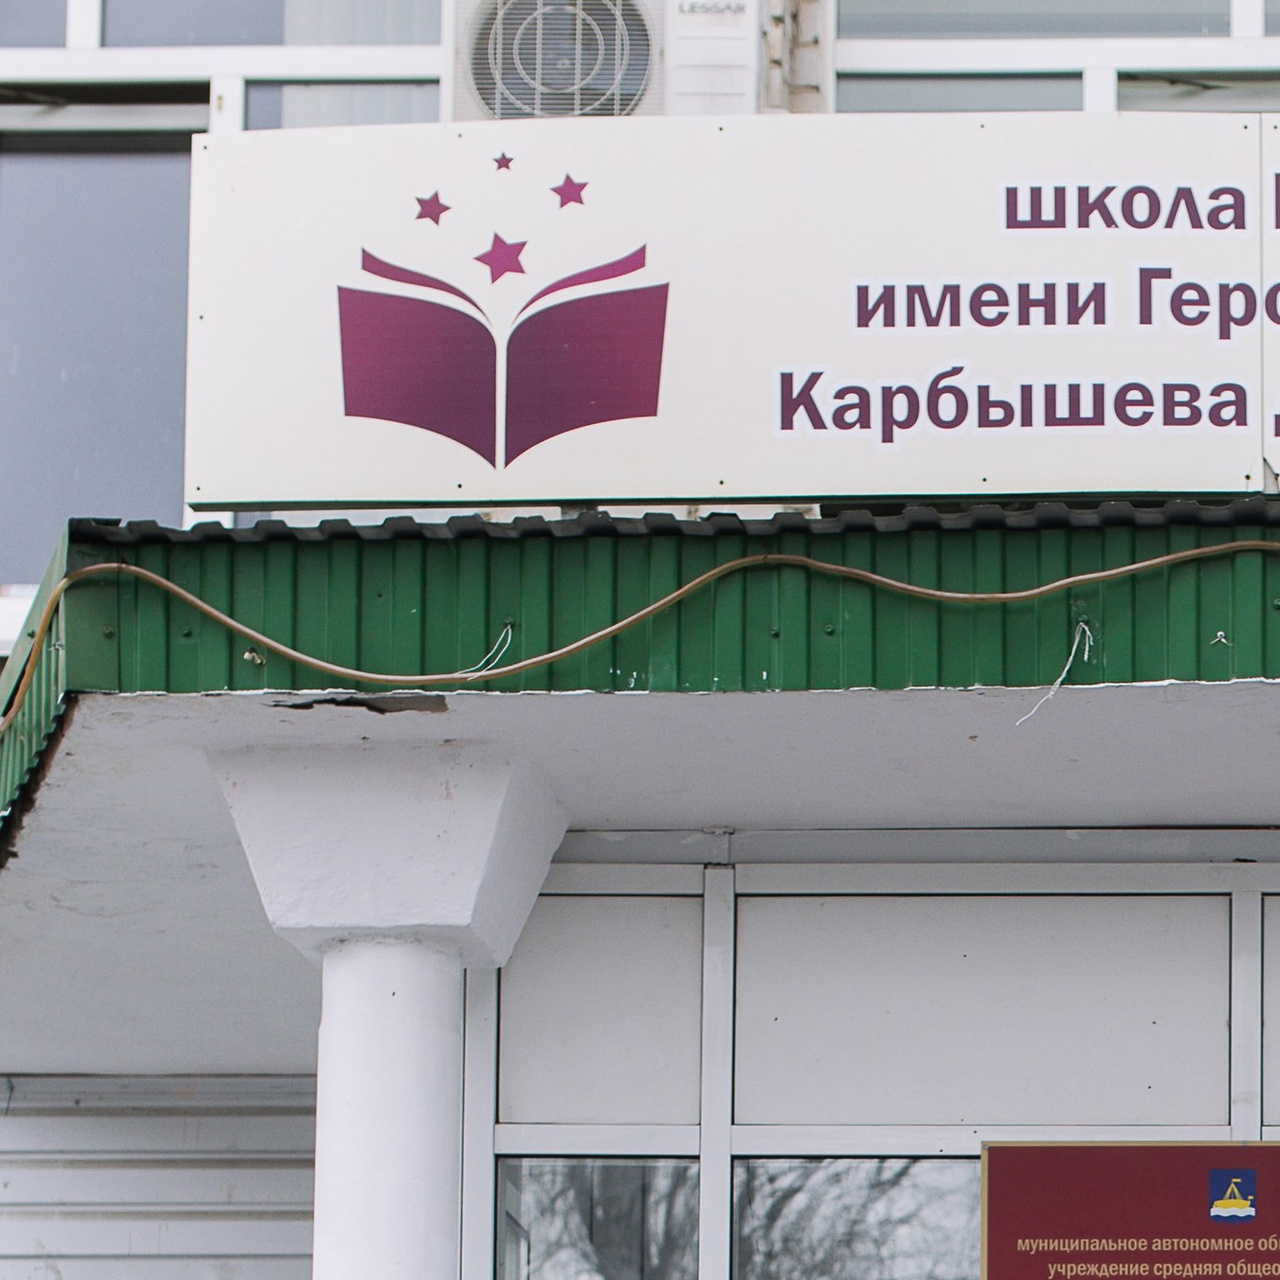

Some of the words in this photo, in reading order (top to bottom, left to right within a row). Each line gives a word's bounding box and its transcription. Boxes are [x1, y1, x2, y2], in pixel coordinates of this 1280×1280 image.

[1006, 186, 1246, 232] школа
[857, 283, 1107, 329] имени
[781, 367, 1248, 445] Карбышева
[1016, 1237, 1148, 1255] муниципальное
[1151, 1237, 1255, 1252] автономное
[1047, 1262, 1150, 1280] учреждение
[1153, 1262, 1223, 1280] средняя
